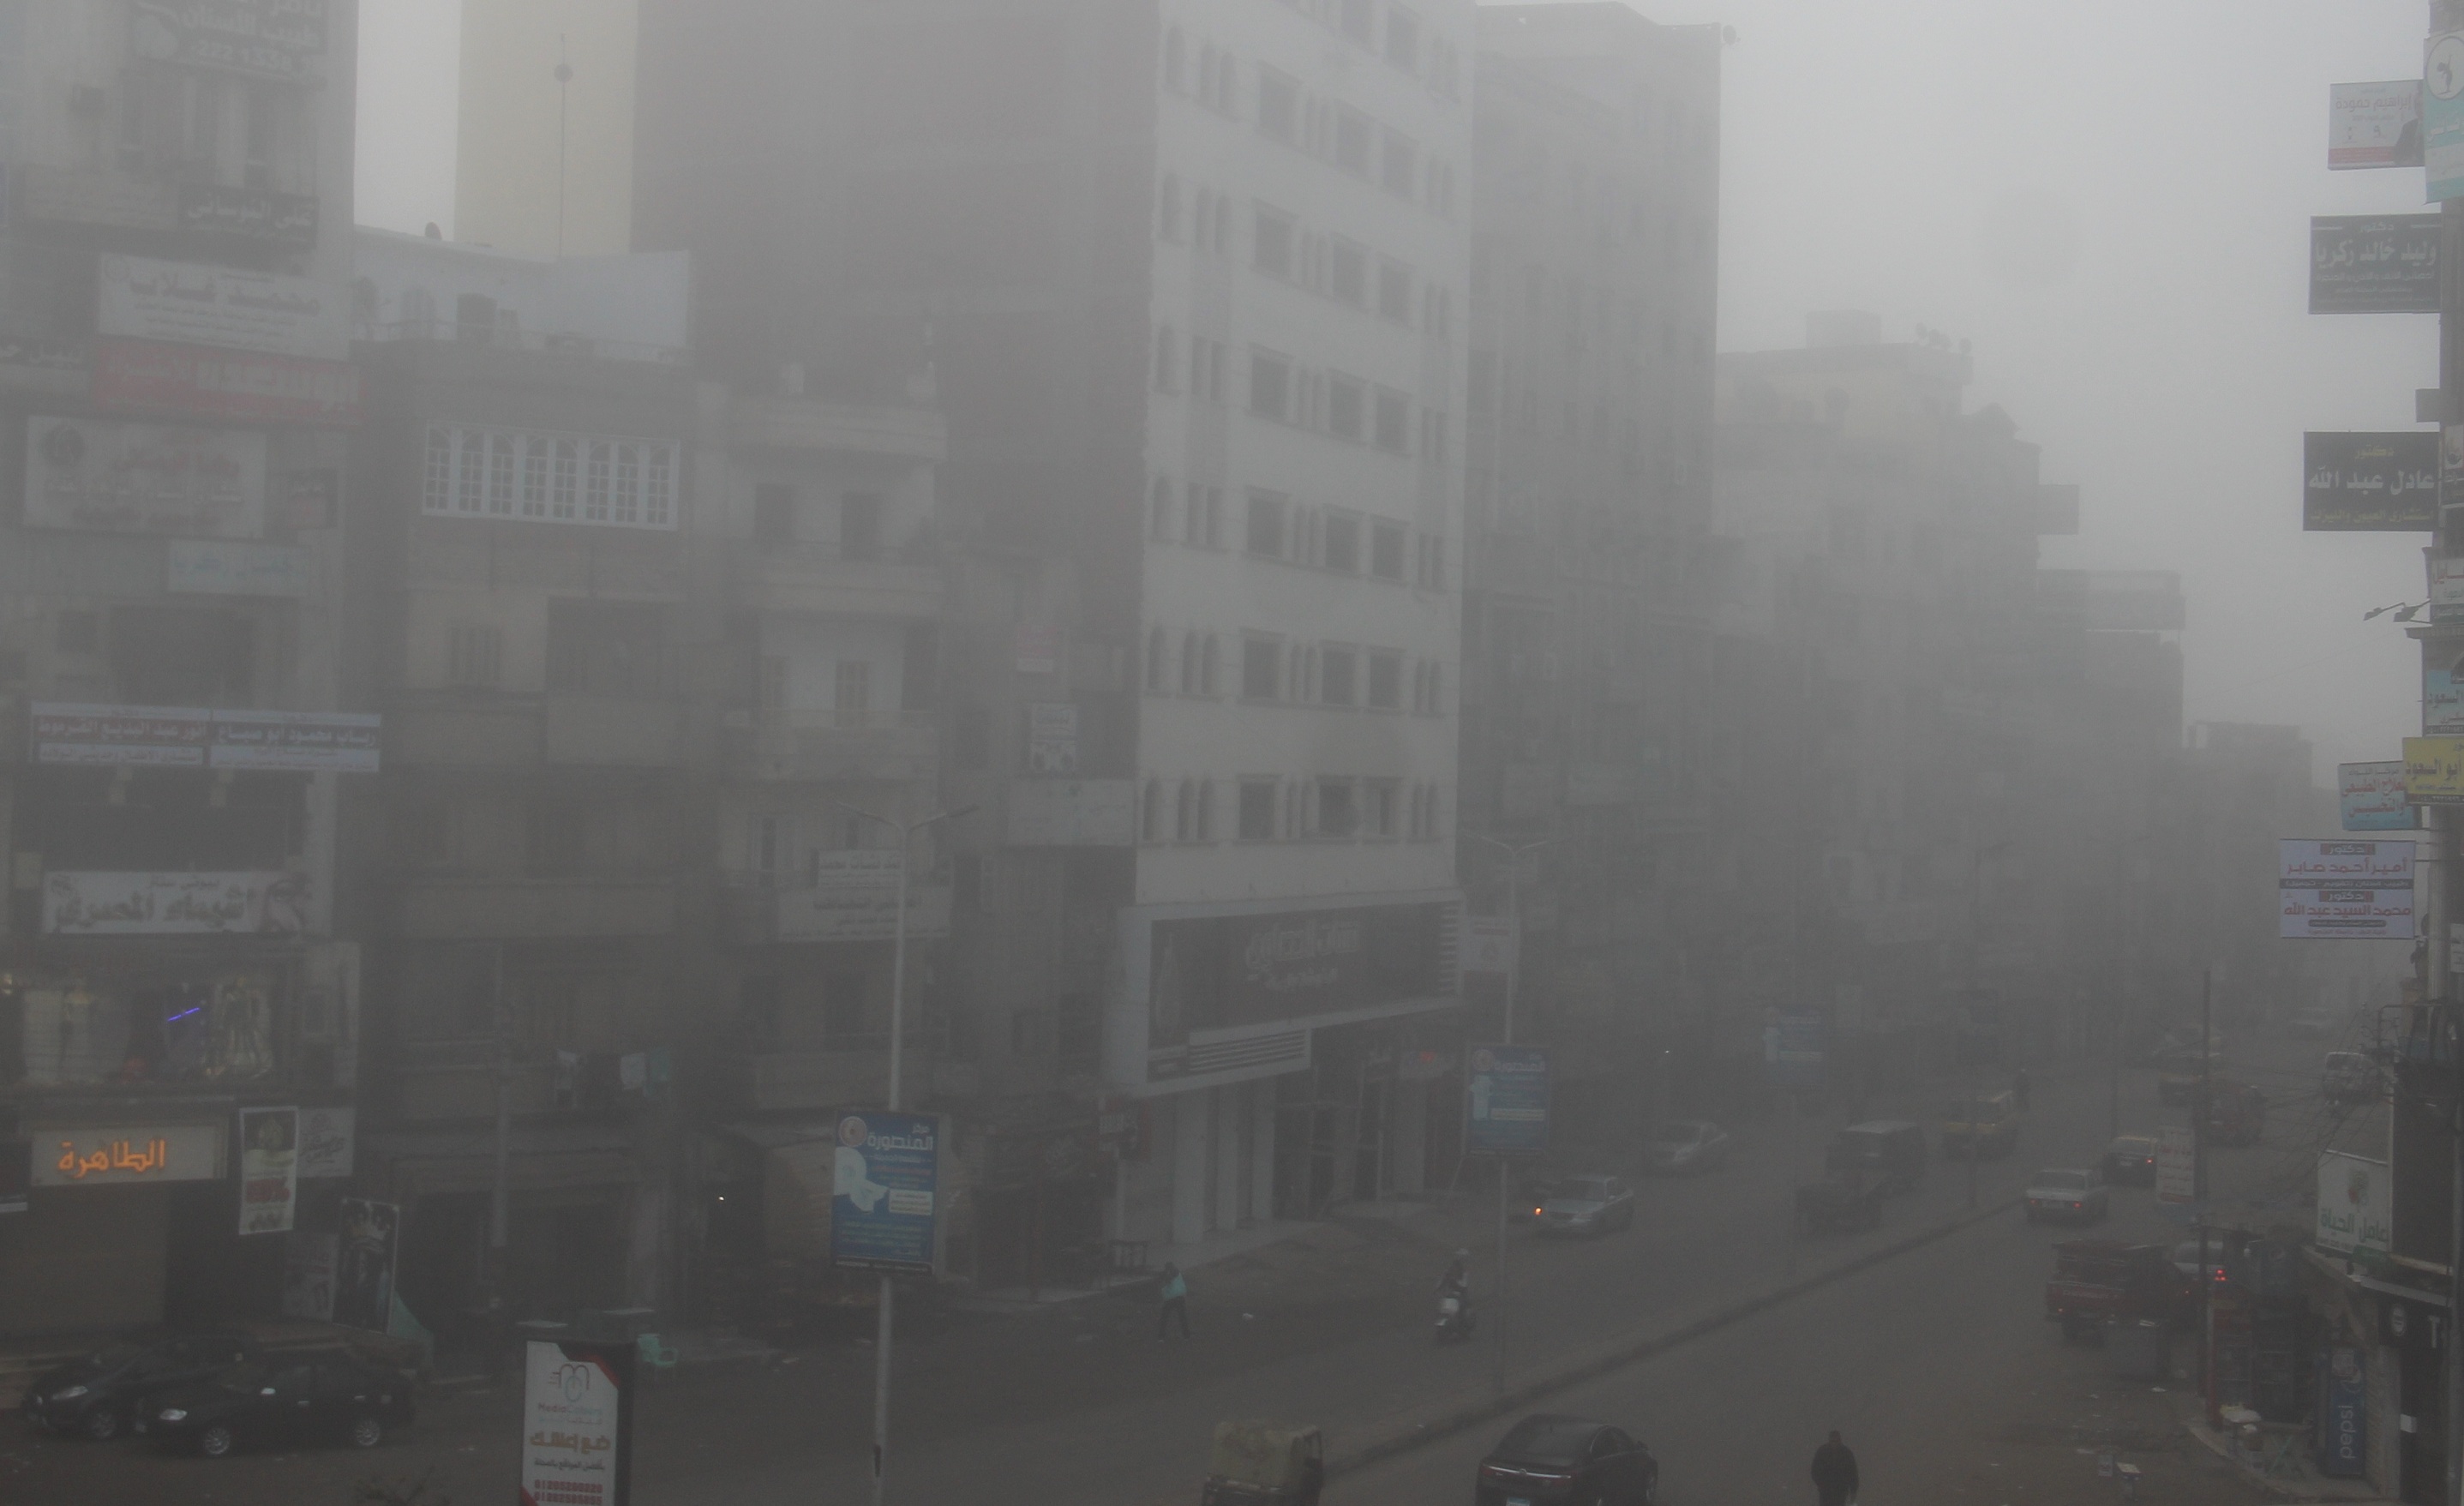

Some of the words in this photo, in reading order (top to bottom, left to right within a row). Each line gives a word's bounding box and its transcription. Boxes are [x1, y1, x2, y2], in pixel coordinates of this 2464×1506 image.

[2335, 97, 2371, 113] حمودة
[2360, 221, 2395, 233] دكتور
[2316, 237, 2355, 269] زكريا
[2359, 237, 2395, 261] خالد
[2401, 240, 2437, 267] وليد
[2355, 444, 2395, 459] دكتور
[2308, 465, 2340, 489] الله
[2347, 471, 2384, 495] عبد
[2390, 469, 2435, 495] عادل
[2406, 758, 2442, 780] السعود
[2329, 845, 2365, 855] دكتور
[2287, 861, 2326, 874] صابر
[2329, 857, 2370, 873] أحمد
[2371, 857, 2407, 875] أمير
[2329, 891, 2365, 902] دكتور
[2284, 902, 2305, 915] الله
[2307, 906, 2331, 918] عبد
[2333, 904, 2371, 919] السيد
[2373, 906, 2412, 916] محمد
[866, 1131, 934, 1151] المنصورة
[56, 1137, 167, 1179] الطاهرة
[2320, 1207, 2355, 1237] الحياة
[2359, 1216, 2389, 1244] عامل
[2338, 1405, 2356, 1459] pepsi
